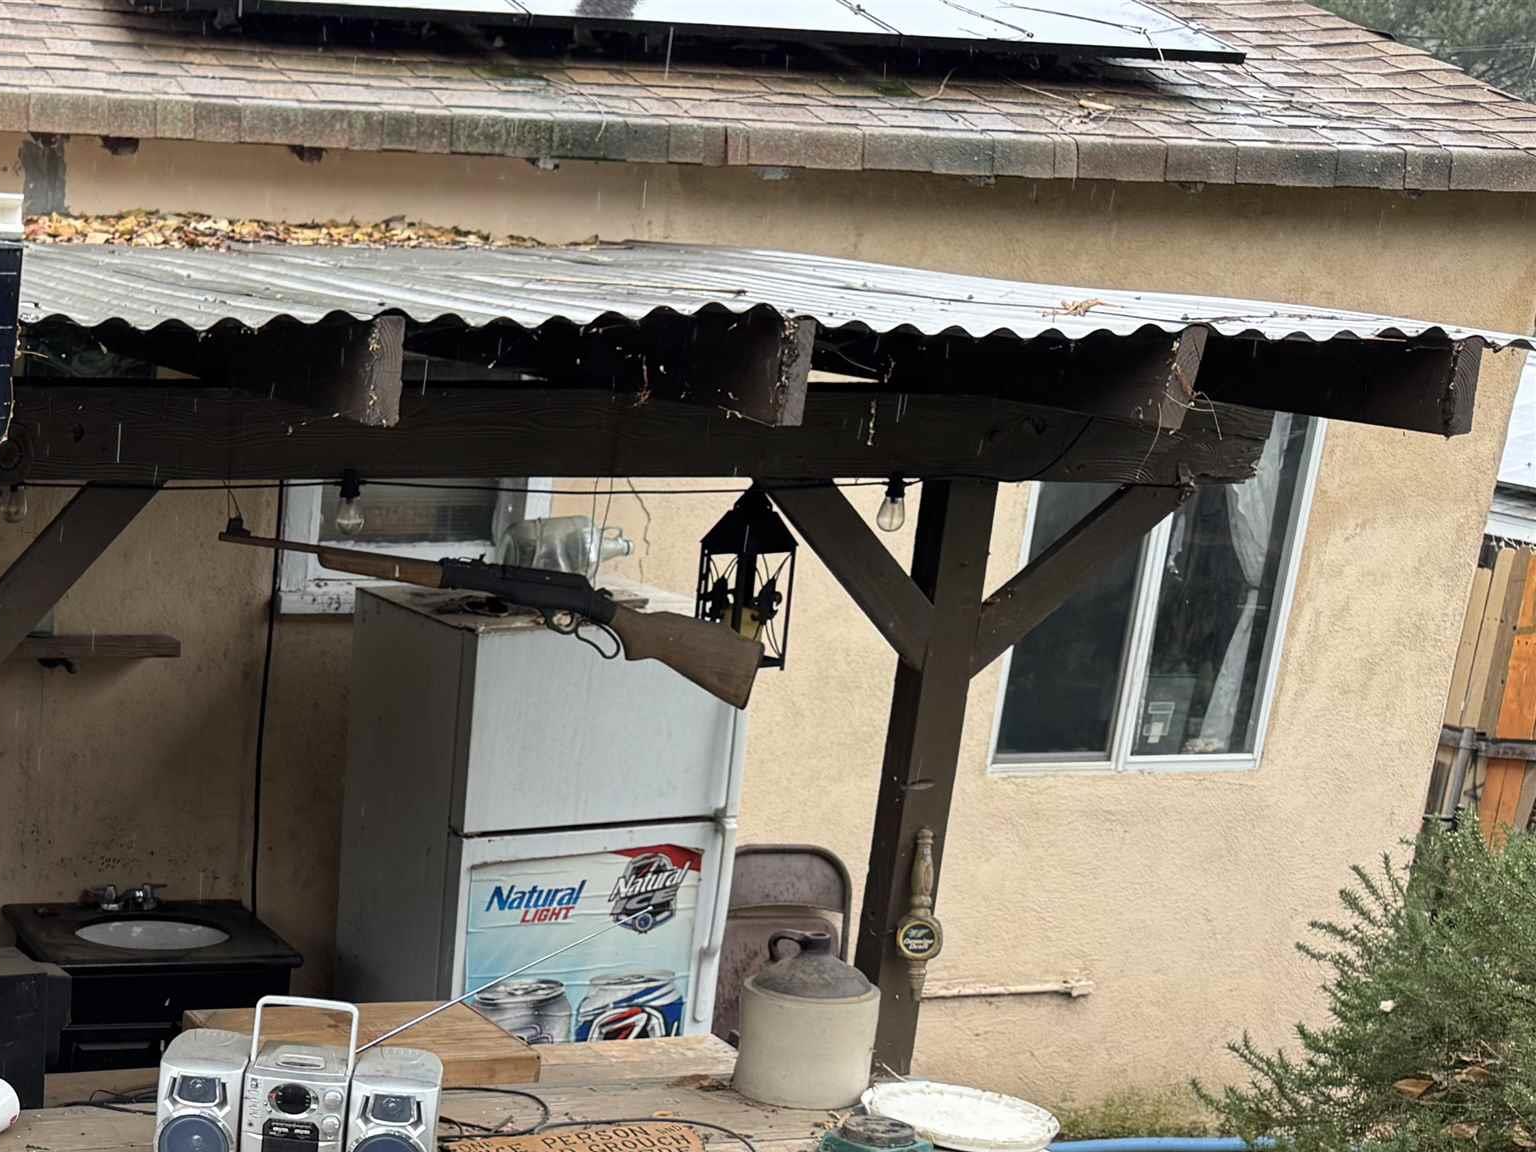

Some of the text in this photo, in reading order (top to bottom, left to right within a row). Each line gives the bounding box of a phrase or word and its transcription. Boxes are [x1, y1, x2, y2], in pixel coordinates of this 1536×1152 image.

[484, 879, 588, 912] Natural
[607, 860, 692, 903] Natural
[520, 905, 576, 924] LIGHT
[541, 1126, 651, 1149] PERSON
